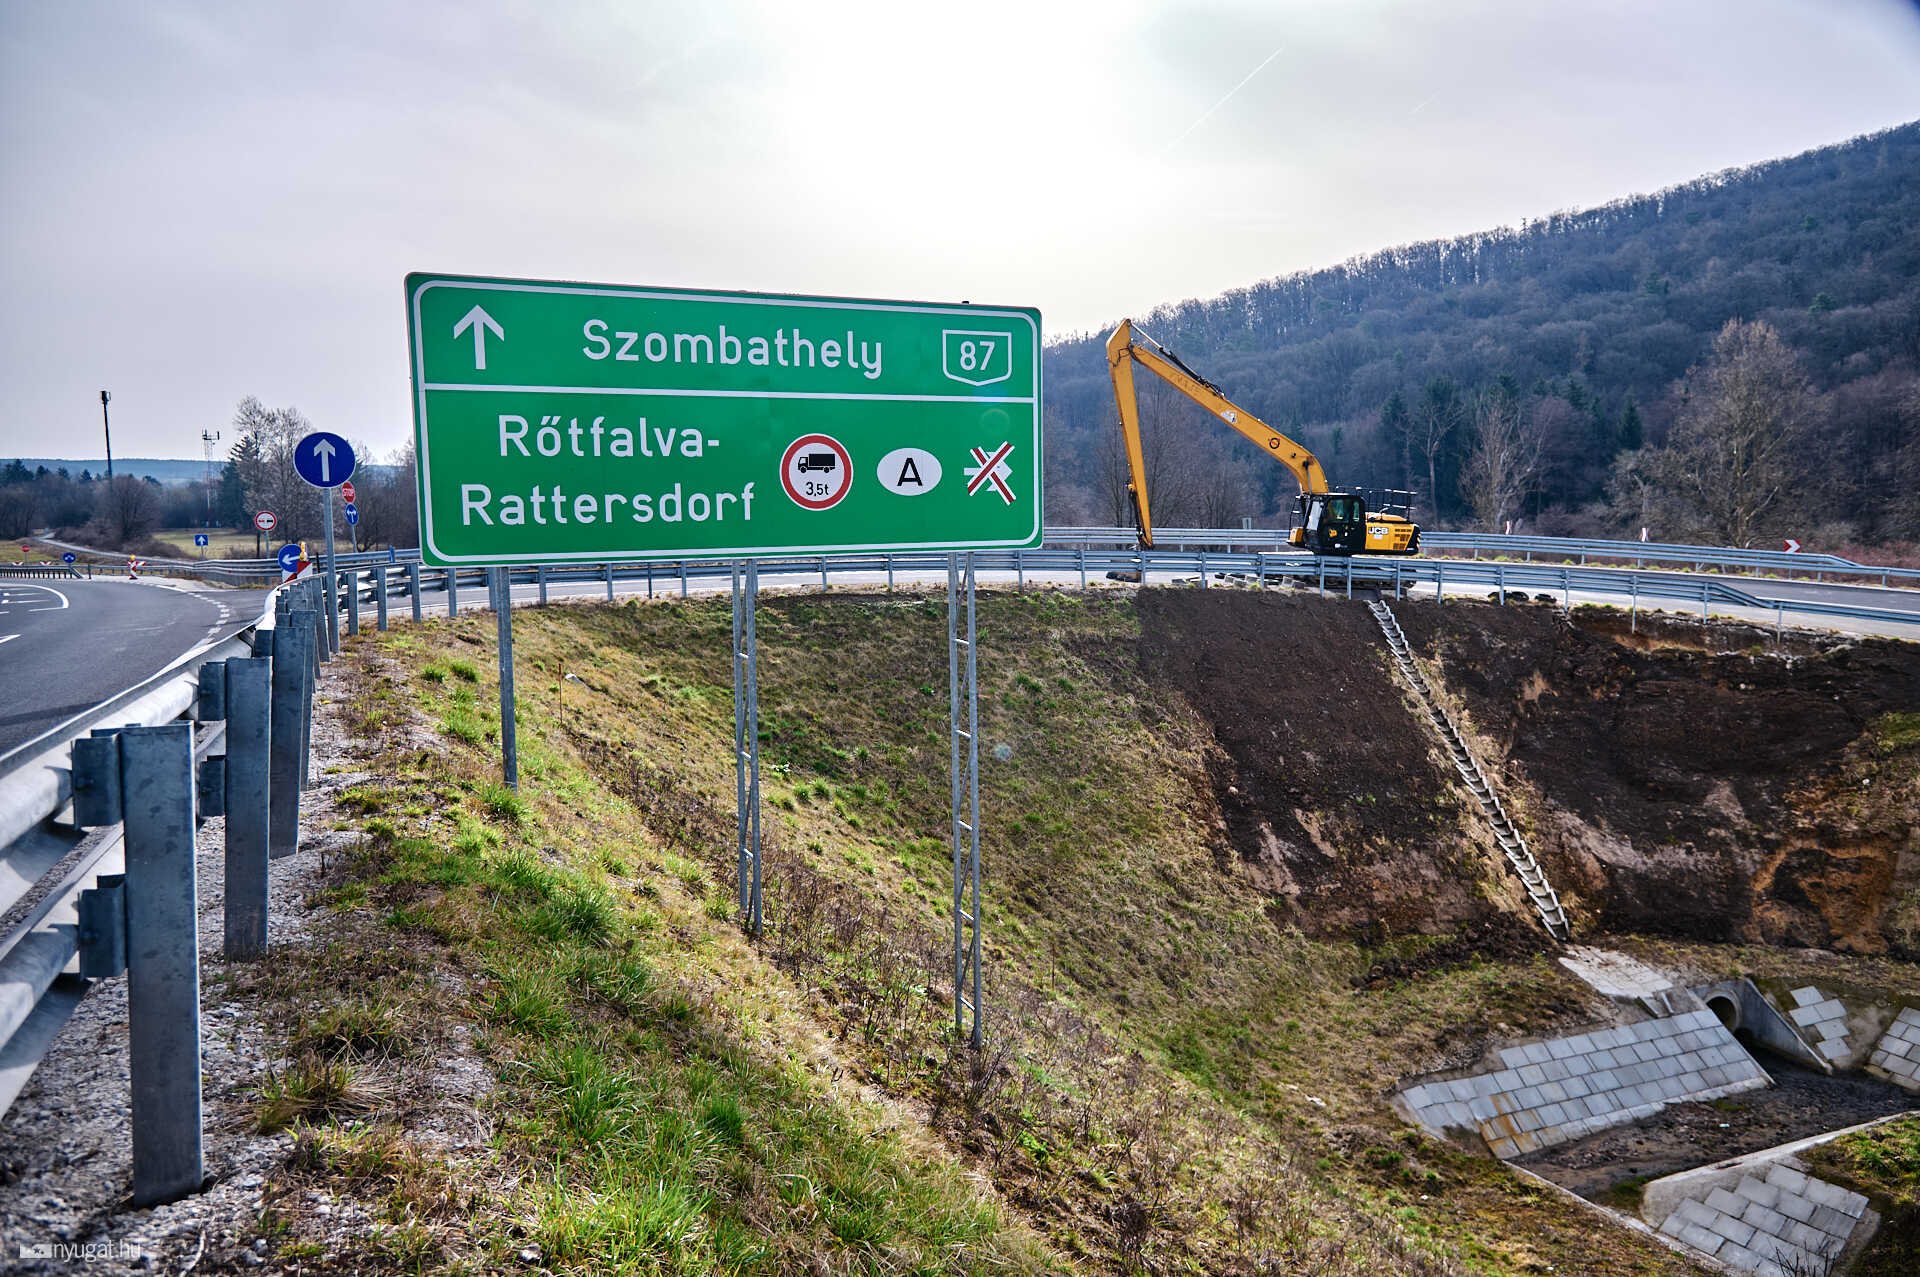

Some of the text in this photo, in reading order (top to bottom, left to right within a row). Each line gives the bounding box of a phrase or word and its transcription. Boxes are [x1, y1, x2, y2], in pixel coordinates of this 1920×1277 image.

[583, 319, 882, 380] Szombathely
[959, 340, 996, 371] 87
[498, 414, 720, 458] Rőtfalva-
[897, 457, 923, 487] A
[461, 482, 755, 526] Rattersdorf
[805, 481, 829, 497] 3,5t
[1368, 526, 1389, 535] JCB
